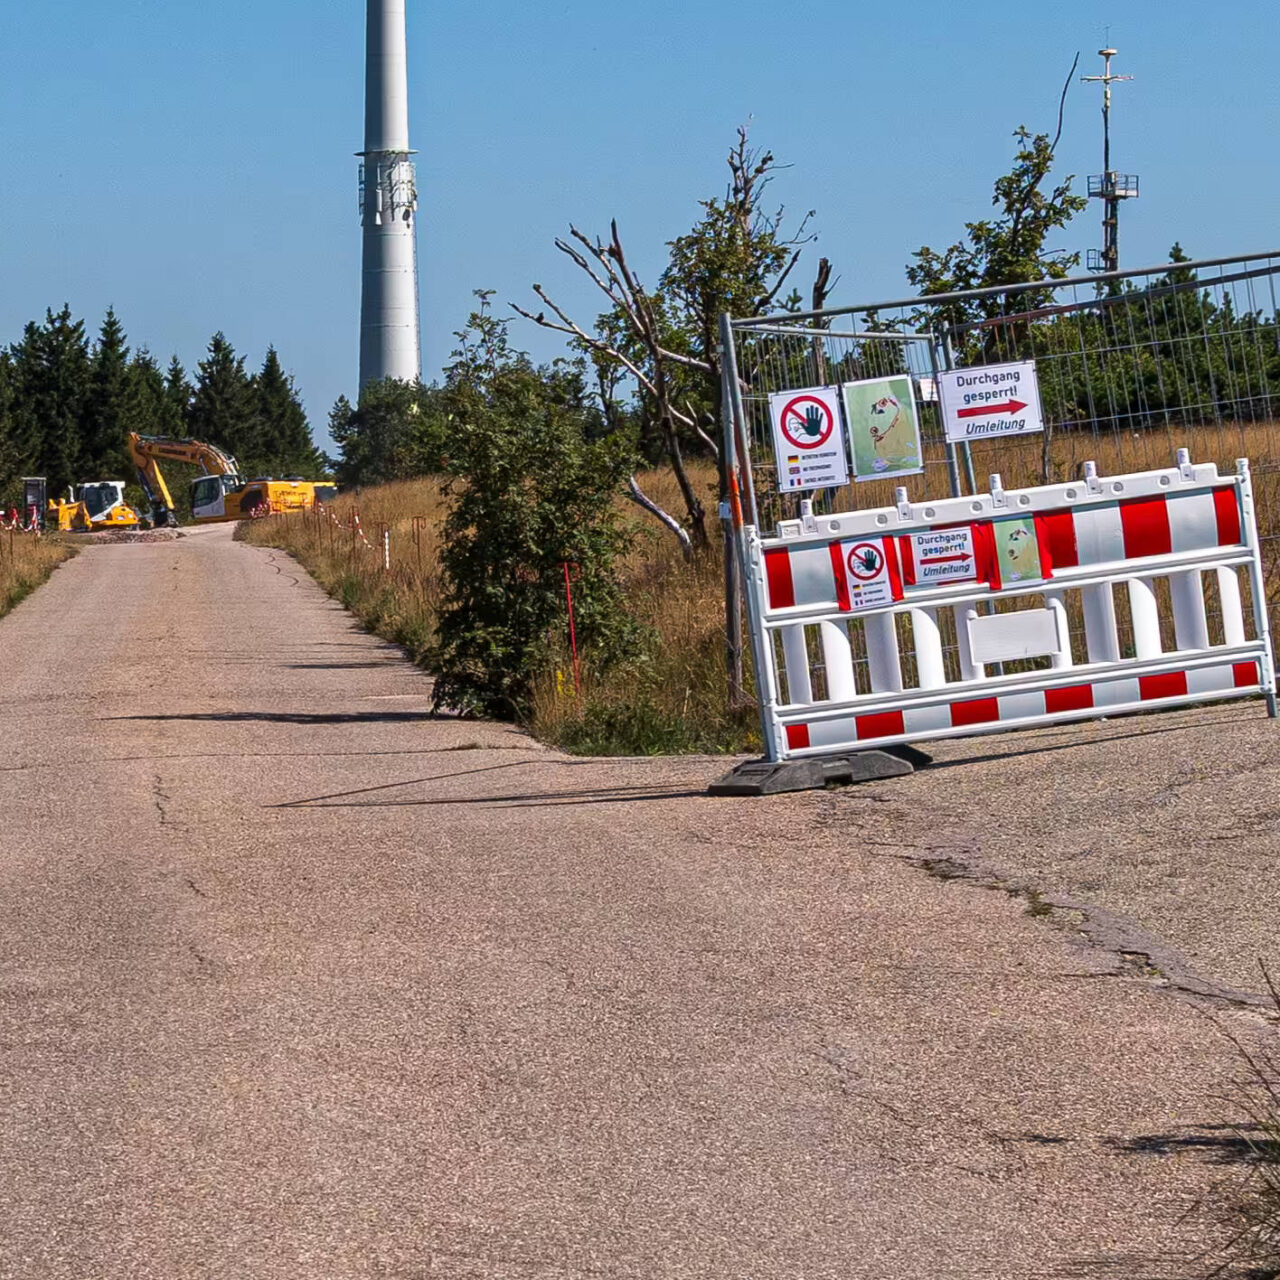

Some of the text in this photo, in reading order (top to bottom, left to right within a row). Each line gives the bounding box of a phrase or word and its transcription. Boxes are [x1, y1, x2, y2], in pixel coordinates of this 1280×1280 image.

[956, 370, 1020, 389] Durchgang
[963, 386, 1018, 405] gesperrt!
[965, 417, 1025, 435] Umleitung
[917, 531, 968, 546] Durchgang
[922, 542, 965, 557] gesperrt!
[923, 562, 970, 578] Umleitung
